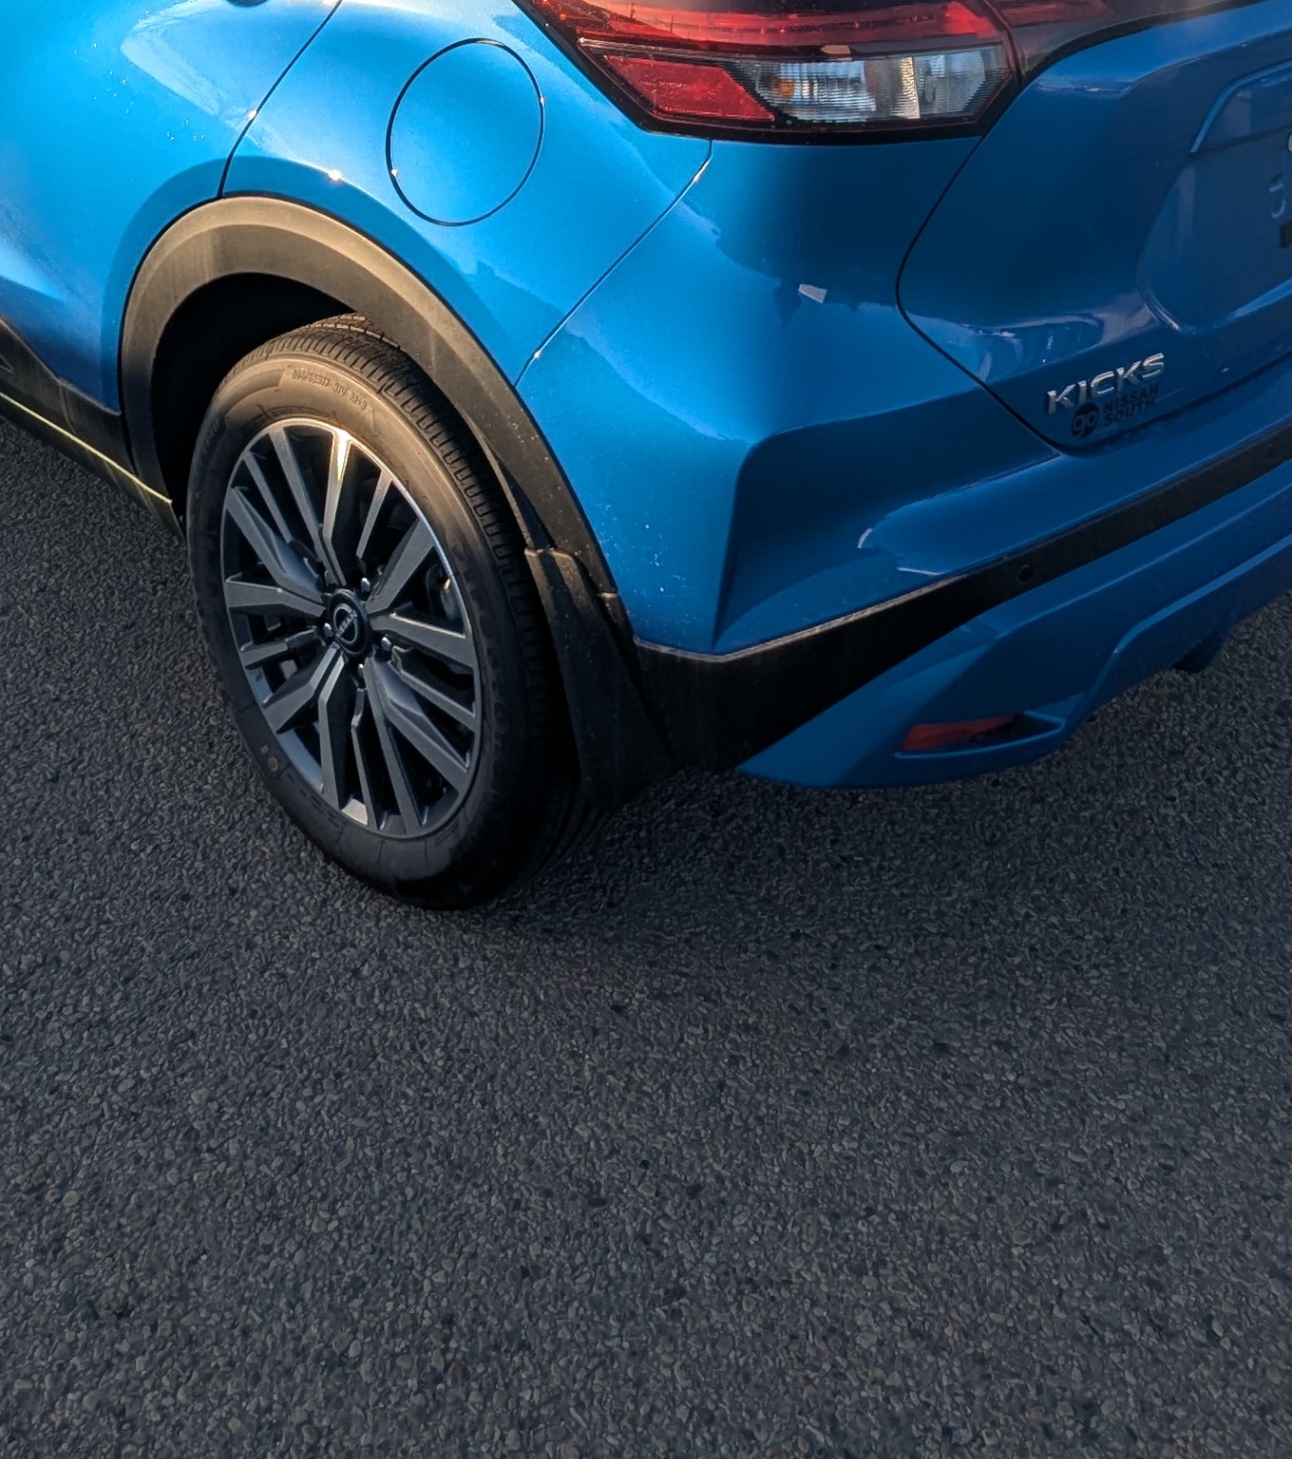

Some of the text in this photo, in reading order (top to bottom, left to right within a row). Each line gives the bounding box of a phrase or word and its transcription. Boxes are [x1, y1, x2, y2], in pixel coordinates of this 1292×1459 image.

[1046, 352, 1165, 414] KICKS
[1103, 383, 1158, 414] NISSAN
[1104, 397, 1156, 426] SOUTH
